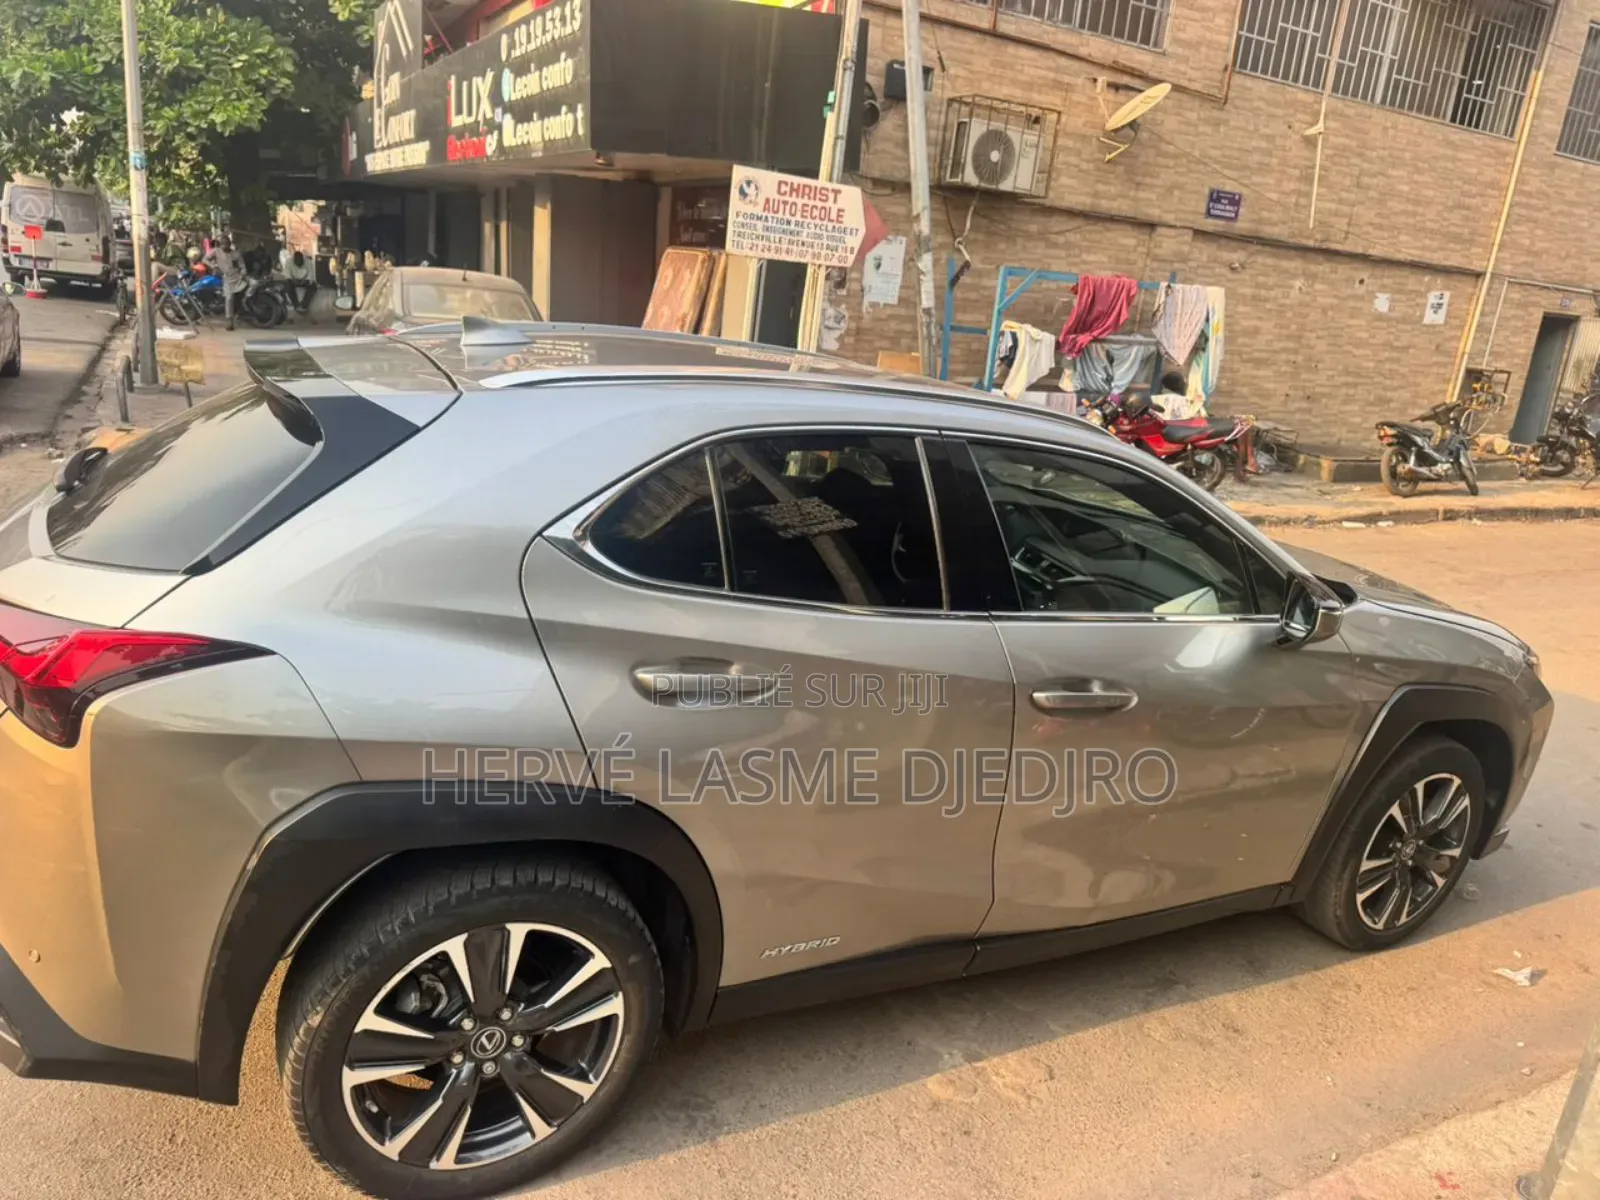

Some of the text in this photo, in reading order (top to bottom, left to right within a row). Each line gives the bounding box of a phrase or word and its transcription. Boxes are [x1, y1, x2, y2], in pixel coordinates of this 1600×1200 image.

[777, 180, 842, 204] CHRIST
[735, 210, 792, 226] FORMATION
[794, 219, 849, 236] RECYCLAGE
[759, 935, 841, 960] HYBRID
